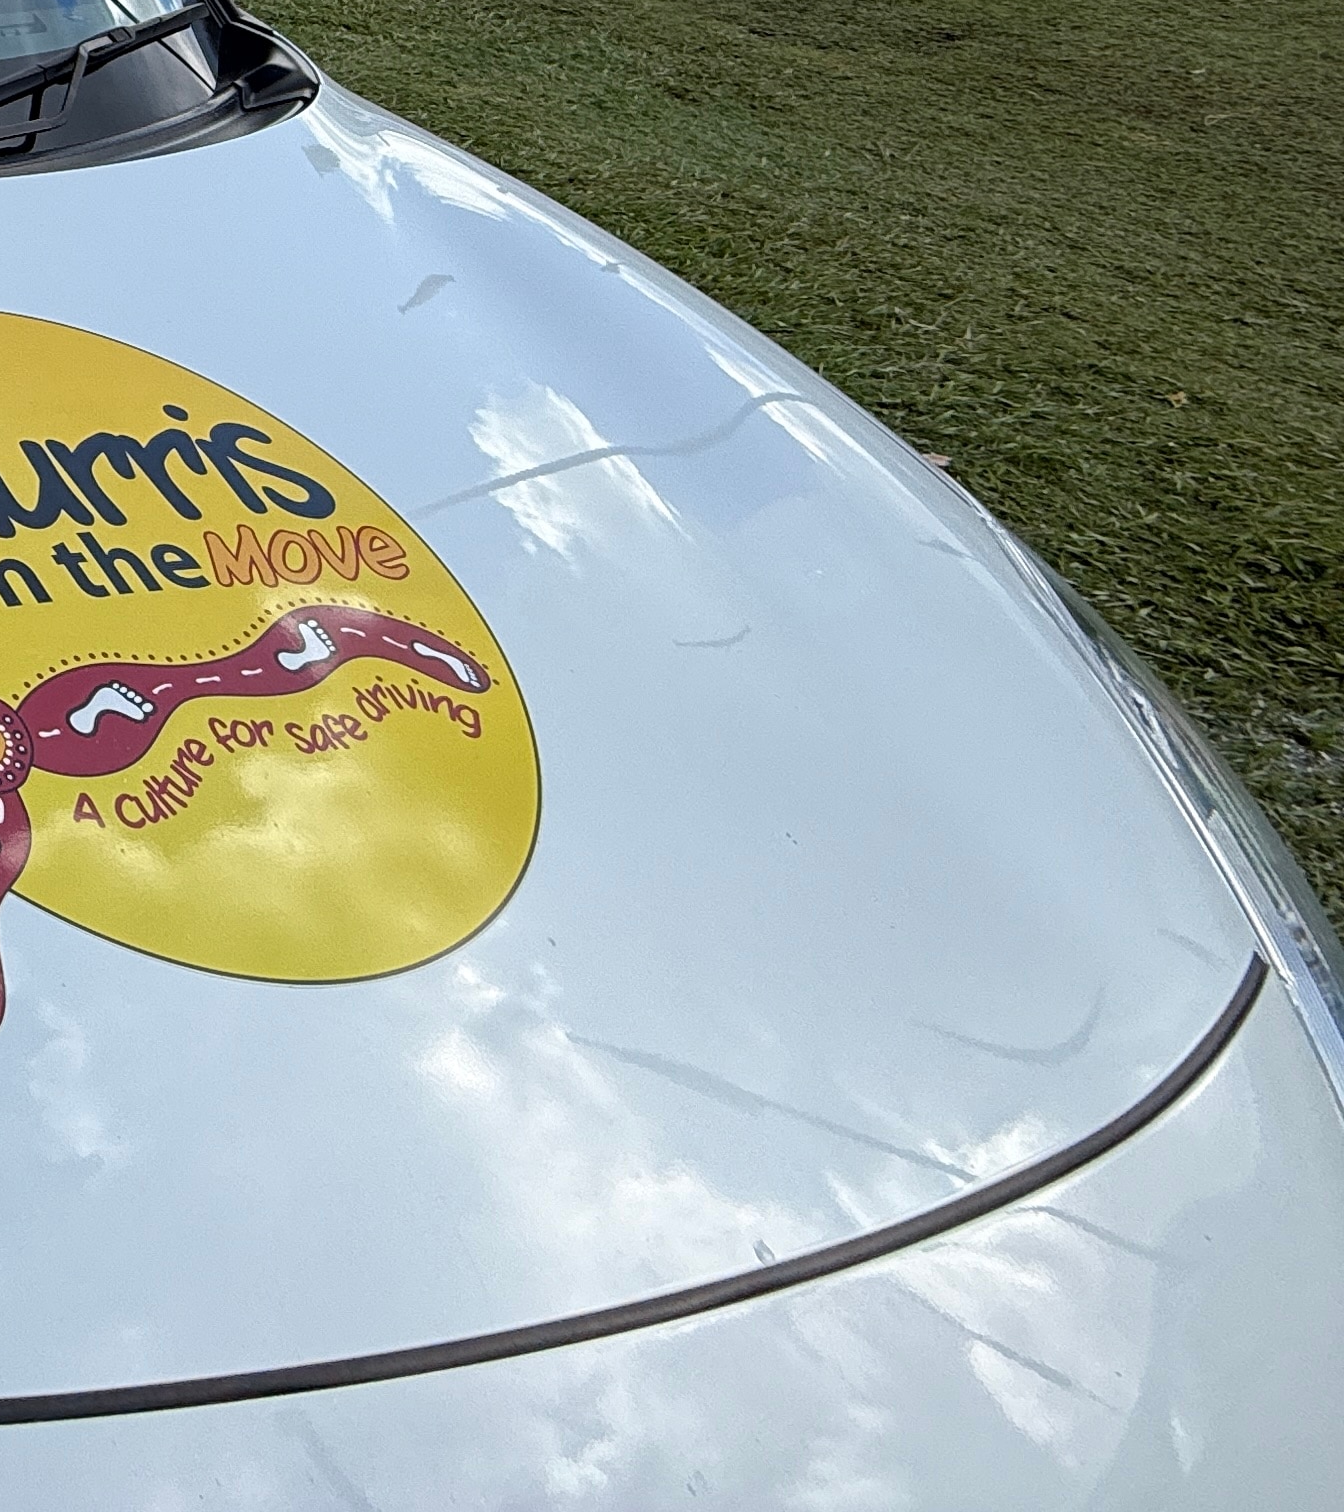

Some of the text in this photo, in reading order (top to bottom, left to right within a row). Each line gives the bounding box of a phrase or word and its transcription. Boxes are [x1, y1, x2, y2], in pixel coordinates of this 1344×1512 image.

[50, 531, 212, 598] the
[73, 792, 106, 829] A
[207, 716, 275, 754] for
[351, 675, 482, 739] driving
